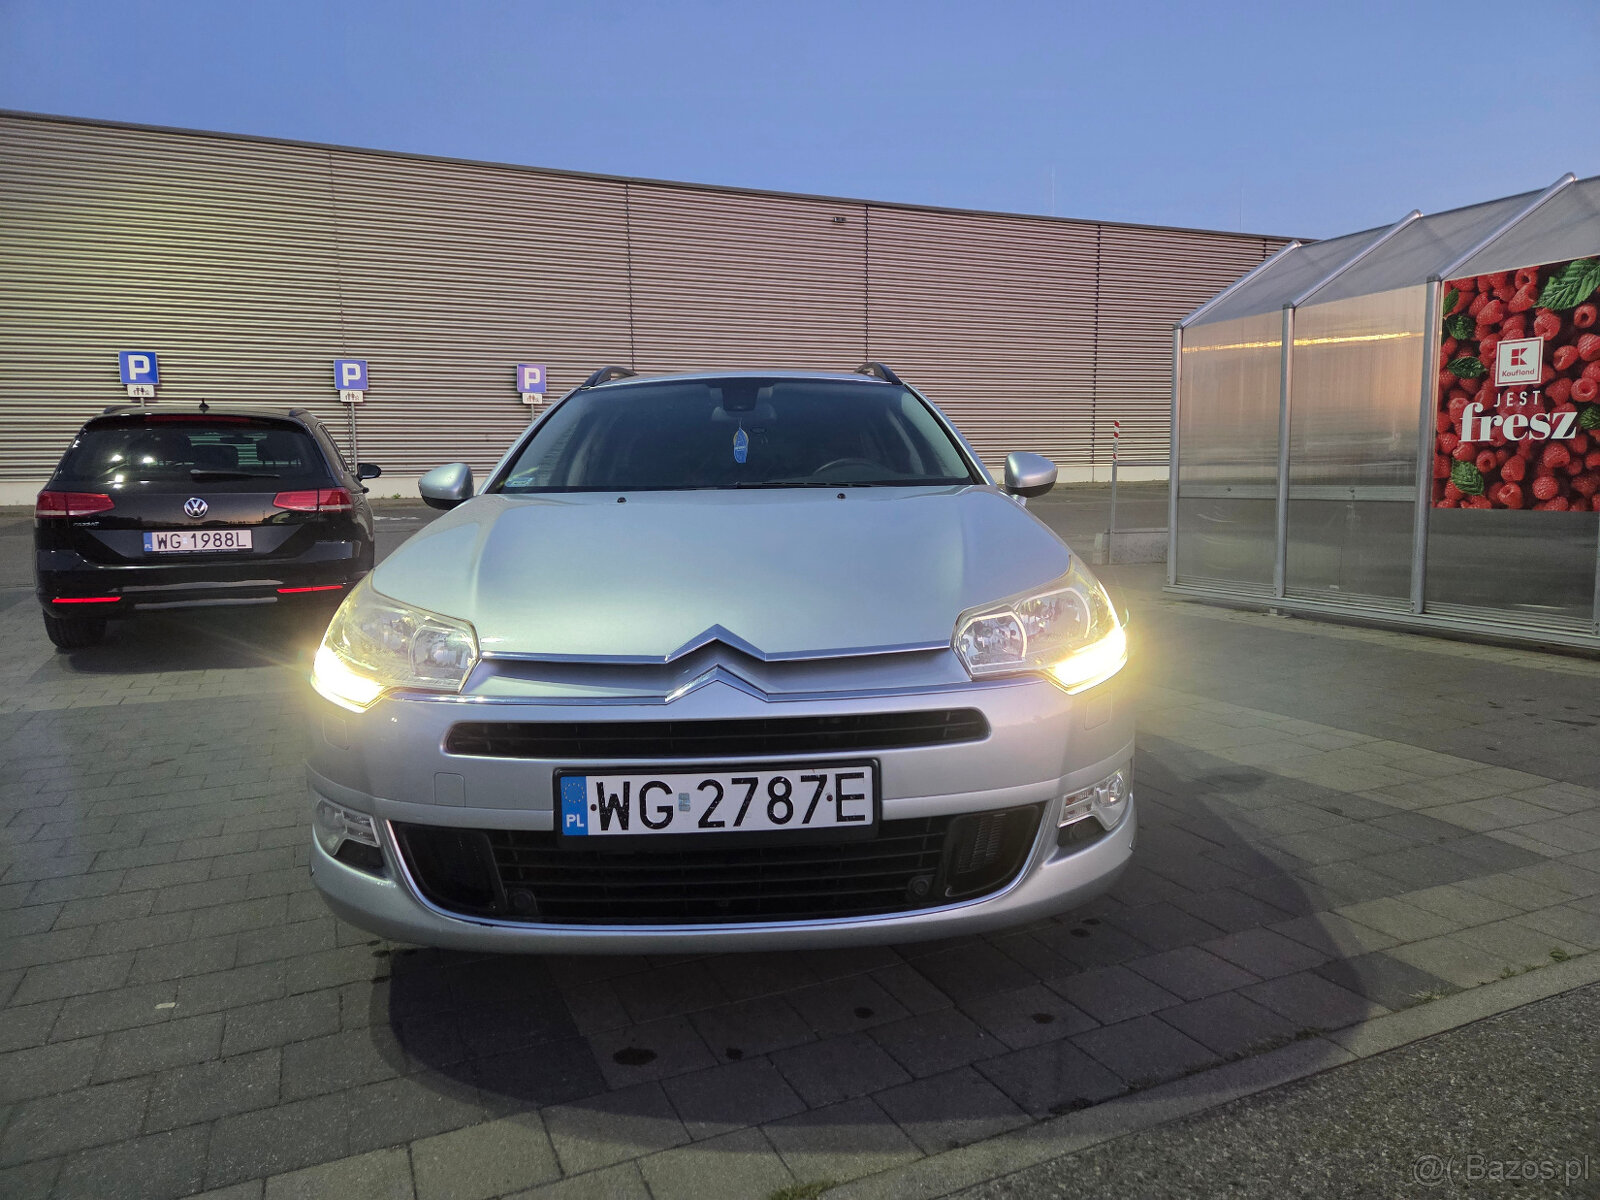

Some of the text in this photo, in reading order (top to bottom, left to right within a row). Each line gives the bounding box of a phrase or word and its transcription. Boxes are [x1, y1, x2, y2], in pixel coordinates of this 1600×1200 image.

[128, 354, 150, 380] P
[342, 363, 361, 386] P
[1502, 368, 1535, 377] Kaufland
[524, 368, 541, 389] P
[1493, 390, 1541, 407] JEST
[1458, 402, 1578, 443] fresz
[156, 532, 247, 549] WG 1988L
[596, 772, 866, 831] WG 2787E
[566, 814, 585, 828] PL
